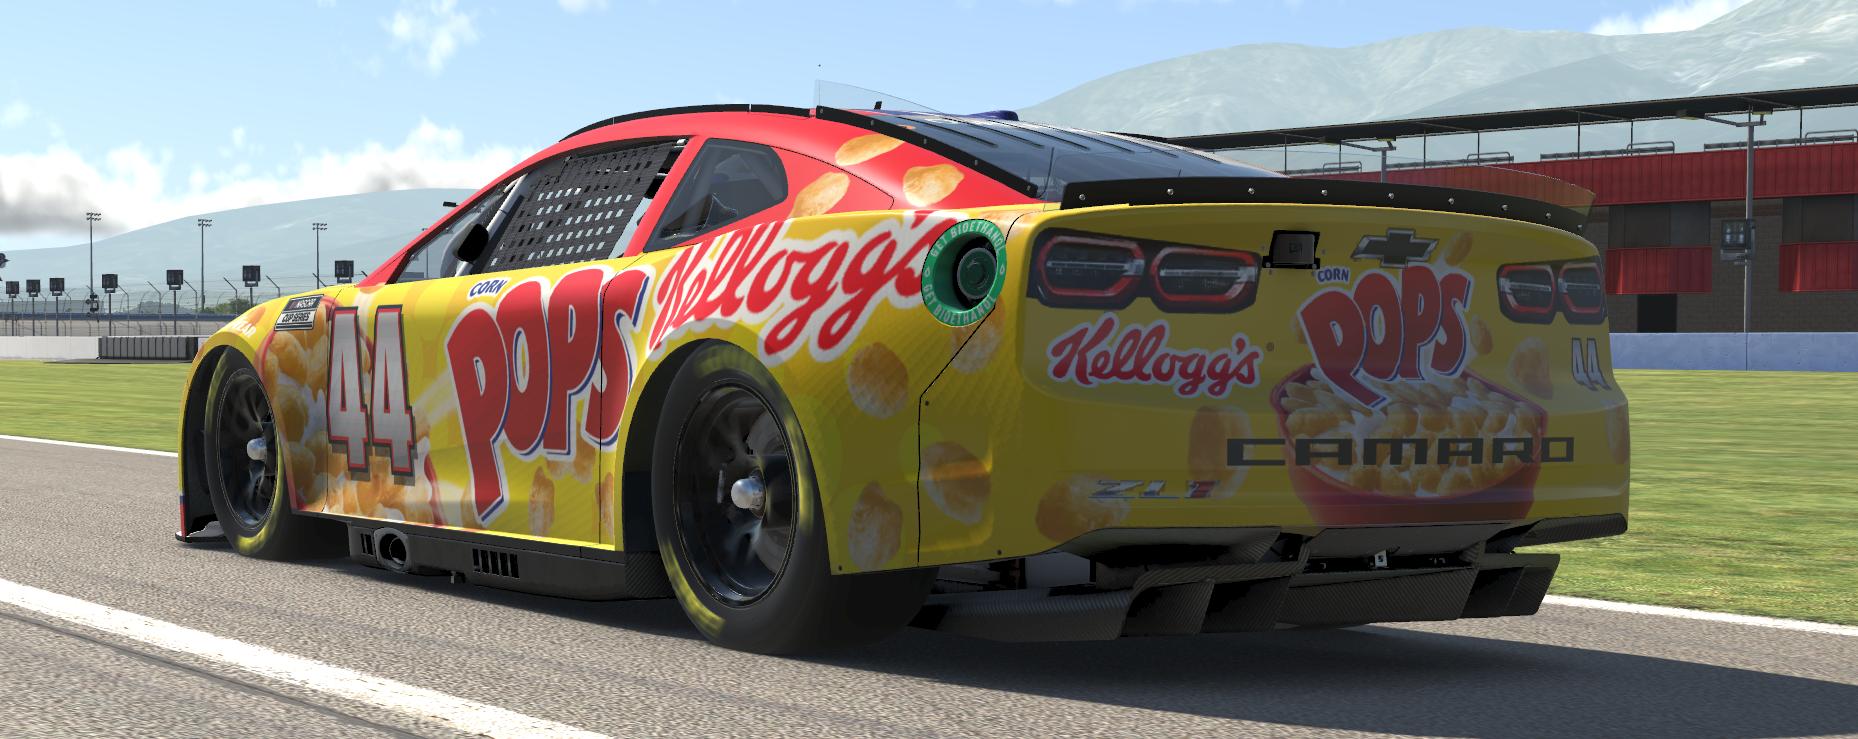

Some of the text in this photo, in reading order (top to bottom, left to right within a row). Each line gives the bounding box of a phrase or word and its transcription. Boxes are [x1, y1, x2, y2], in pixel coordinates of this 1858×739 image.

[930, 221, 1006, 257] GET BIOETHANOL
[469, 279, 508, 297] CORN
[1317, 267, 1350, 283] CORN
[923, 283, 996, 324] GET BIOETHANOL
[1050, 316, 1261, 396] Kellogg's
[1299, 266, 1473, 408] POPS
[1571, 336, 1611, 391] 44
[327, 304, 416, 482] 44
[446, 267, 652, 524] POPS
[1226, 437, 1574, 466] CAMARO
